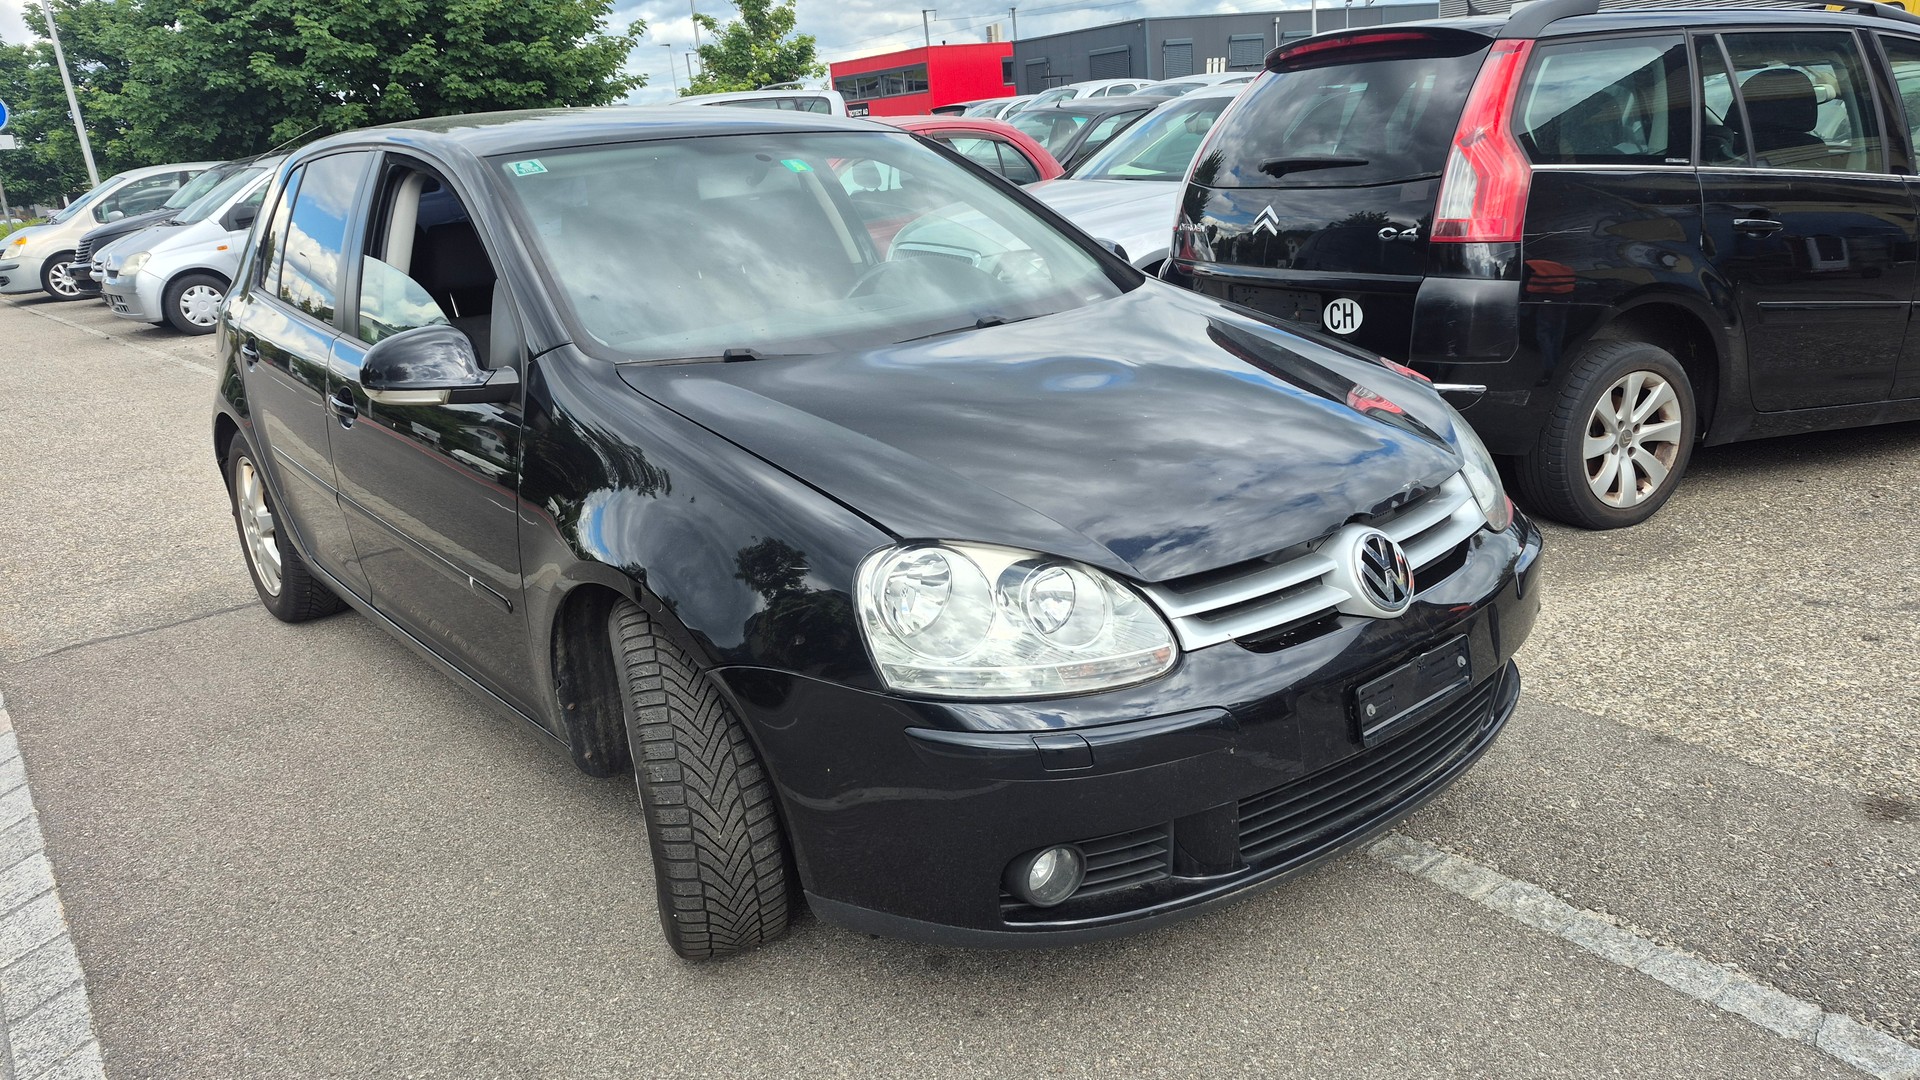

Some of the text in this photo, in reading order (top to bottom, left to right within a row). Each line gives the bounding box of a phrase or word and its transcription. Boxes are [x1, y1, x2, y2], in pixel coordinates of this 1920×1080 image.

[1377, 226, 1419, 242] C4
[1329, 302, 1354, 329] CH
[1360, 533, 1413, 610] VW
